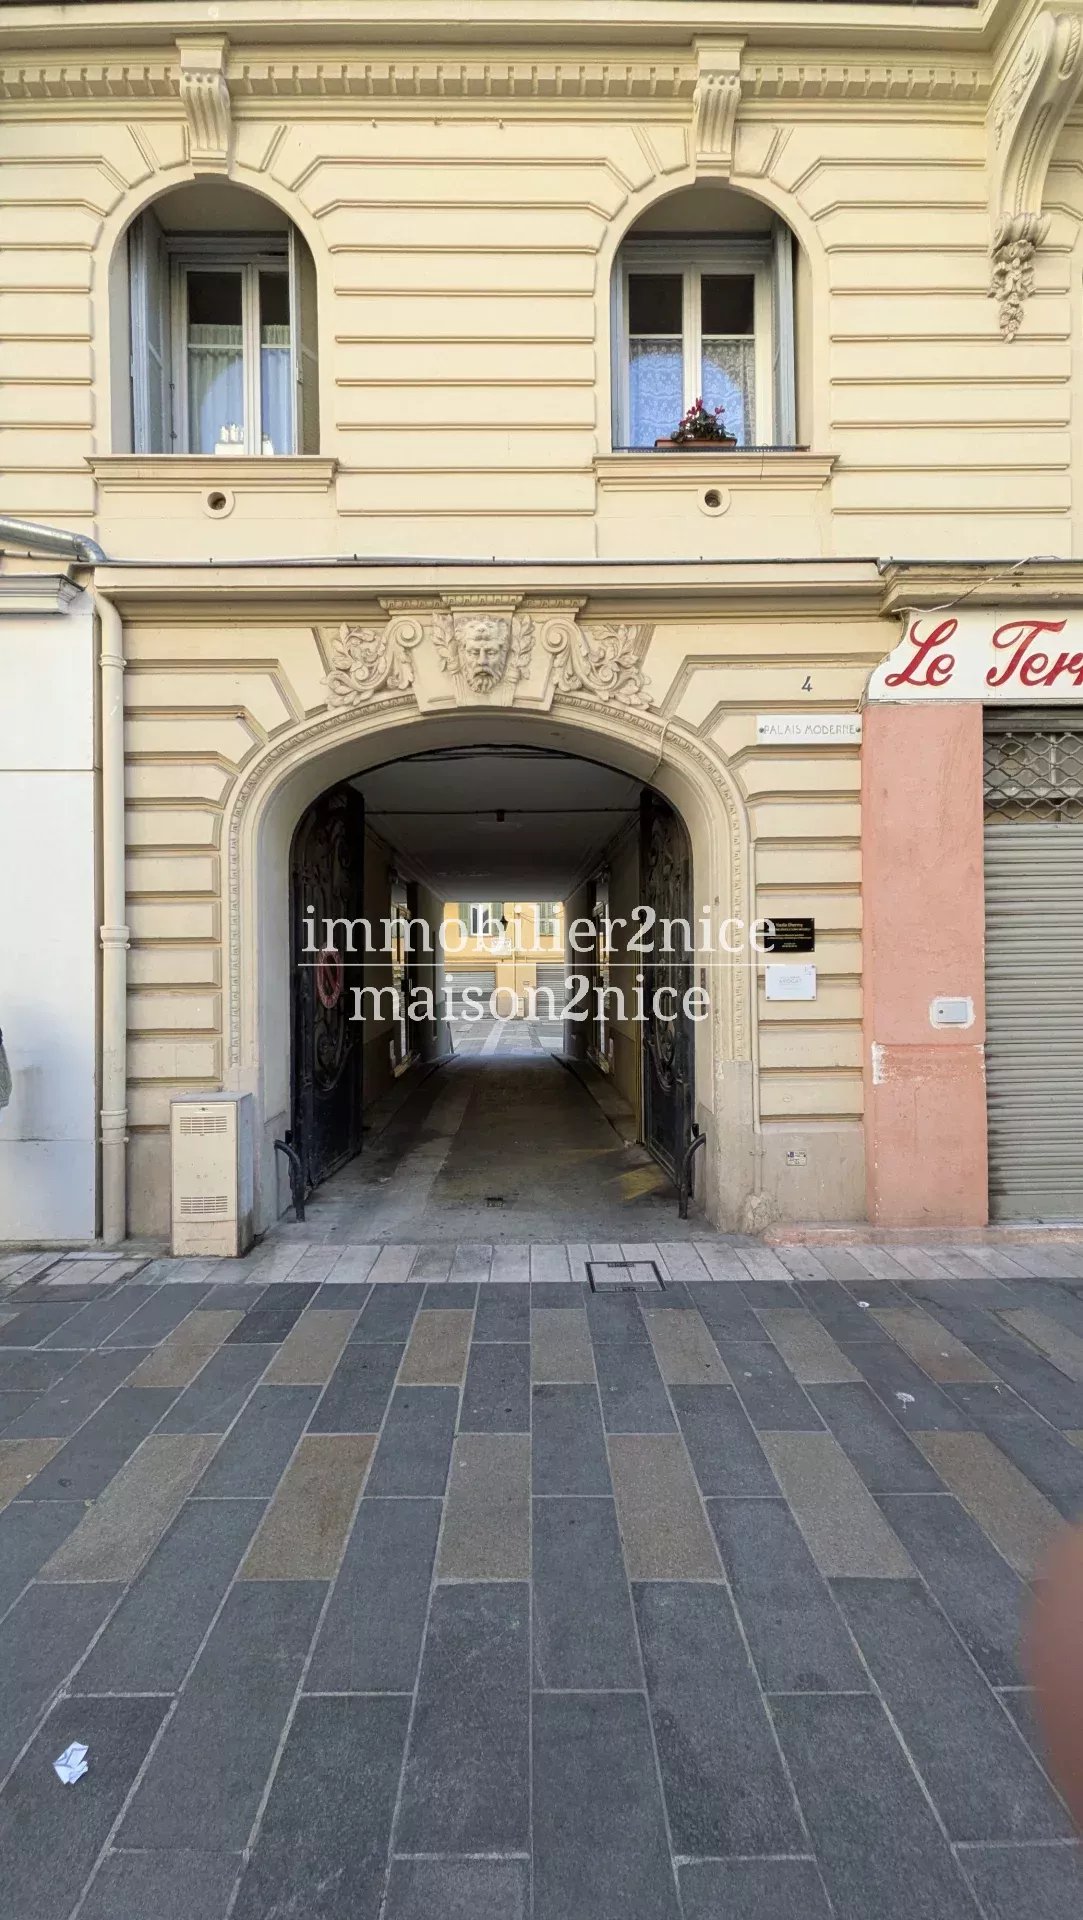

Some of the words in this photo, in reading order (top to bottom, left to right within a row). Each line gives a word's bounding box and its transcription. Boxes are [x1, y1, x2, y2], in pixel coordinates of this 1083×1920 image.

[885, 619, 957, 687] Le
[801, 675, 813, 692] 4
[763, 724, 802, 735] PALAIS
[804, 724, 856, 735] MODERNE
